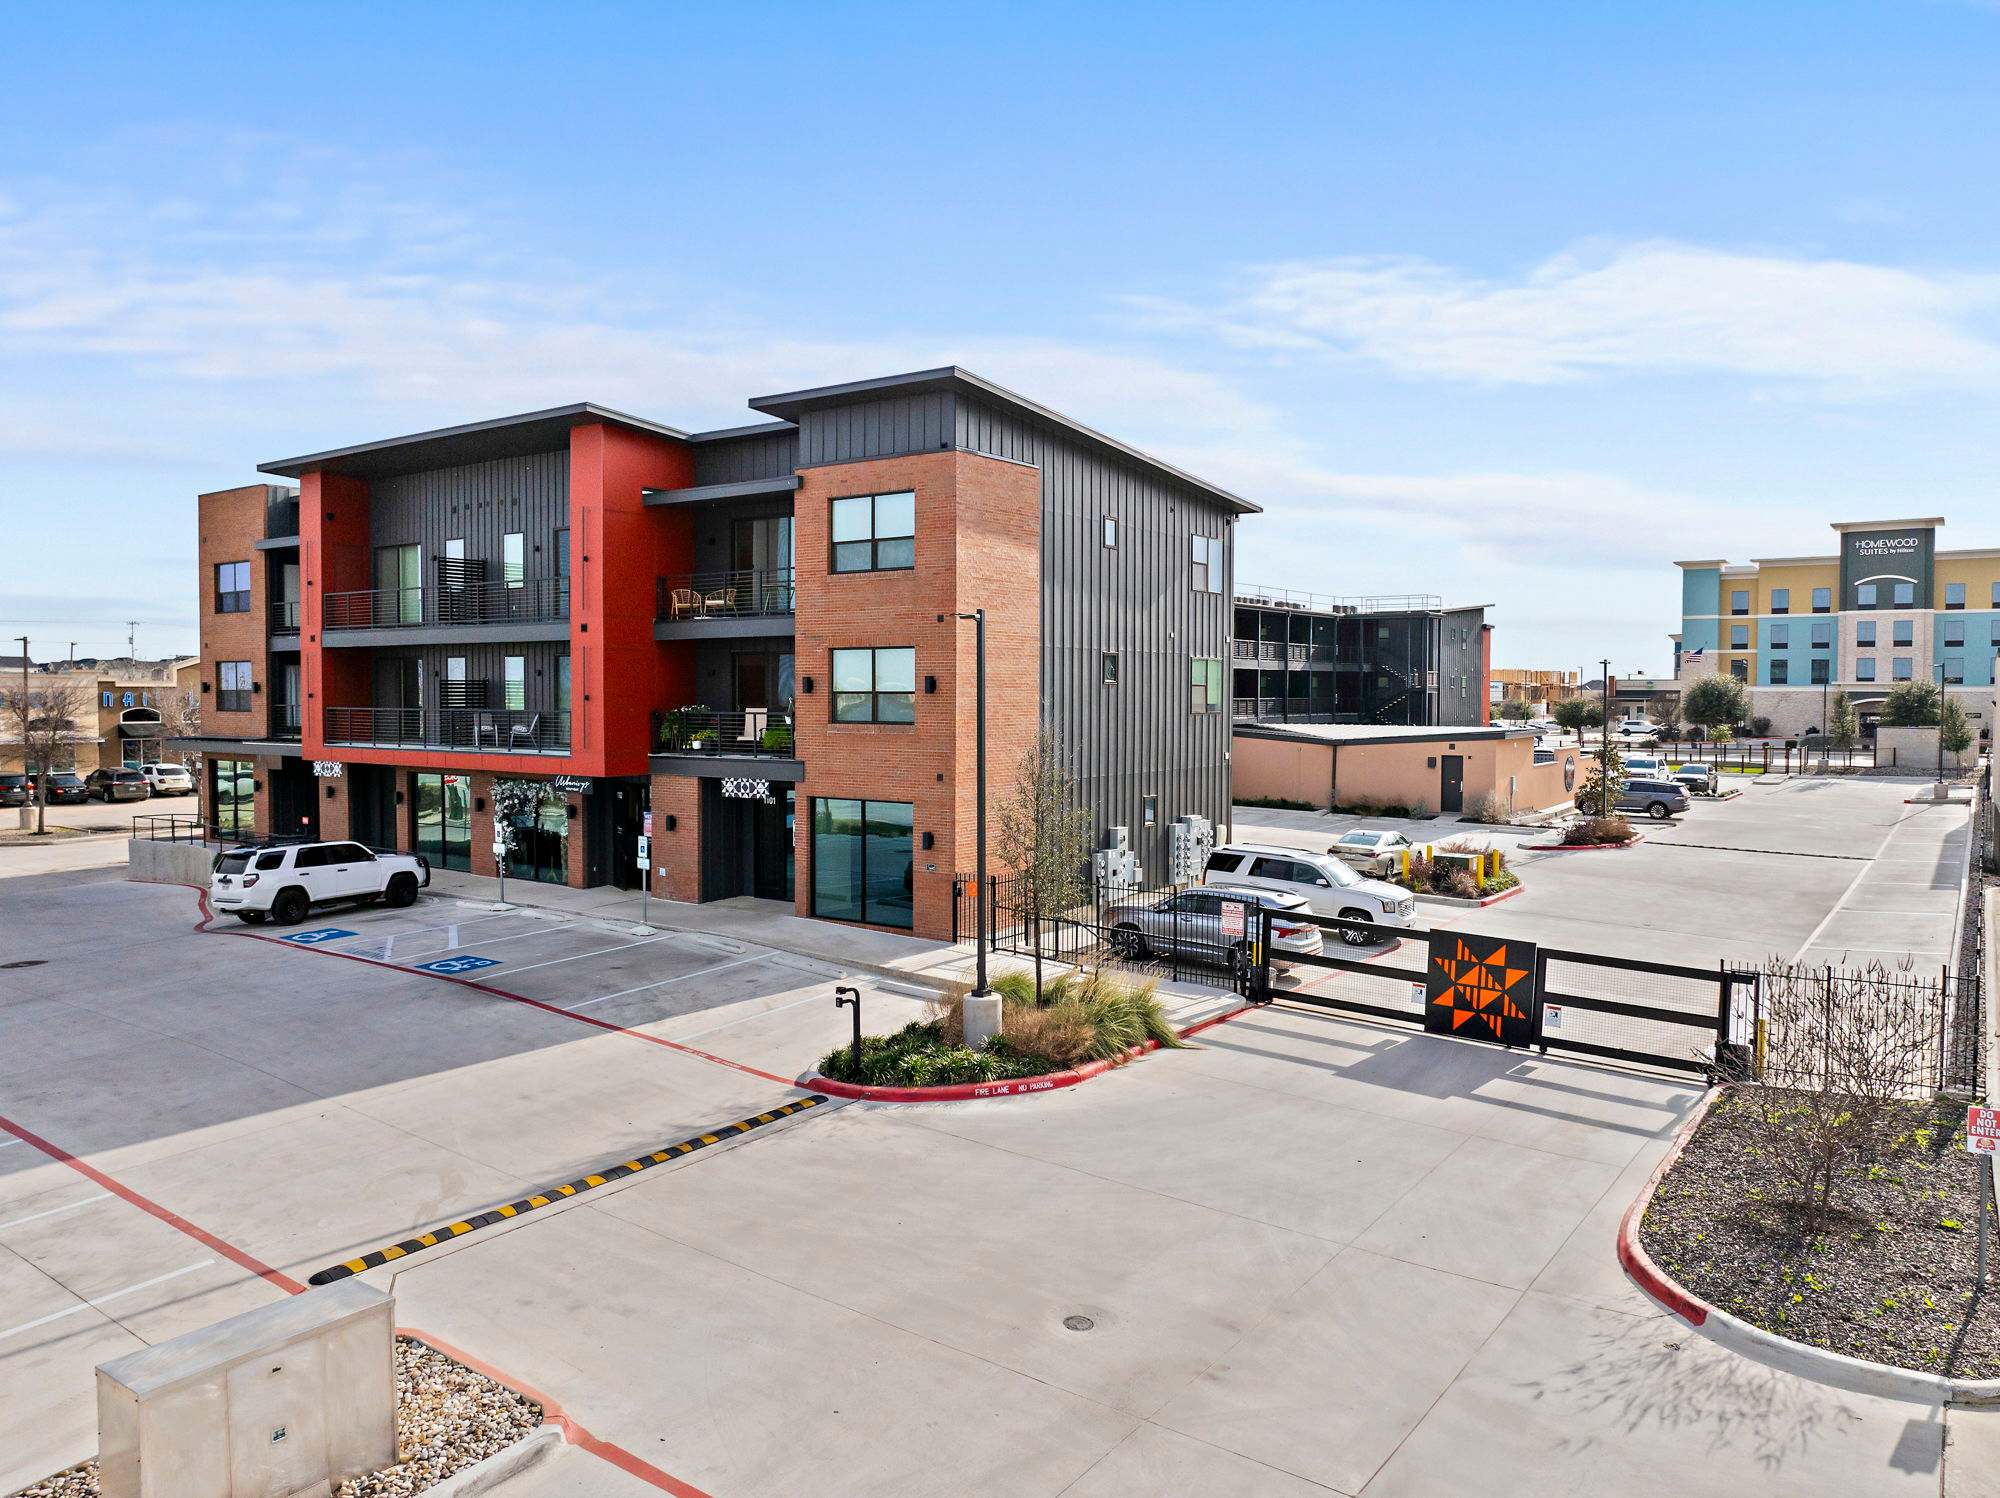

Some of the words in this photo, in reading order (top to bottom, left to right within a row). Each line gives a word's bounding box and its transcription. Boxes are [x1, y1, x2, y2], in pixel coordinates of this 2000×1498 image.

[1855, 538, 1918, 548] HOMEWOOD
[974, 1088, 990, 1096] FIRE
[992, 1086, 1010, 1094] LANE
[1030, 1081, 1054, 1090] PARKING
[1980, 1110, 1994, 1118] DO
[1976, 1118, 1997, 1128] NOT
[1971, 1126, 2000, 1137] ENTER
